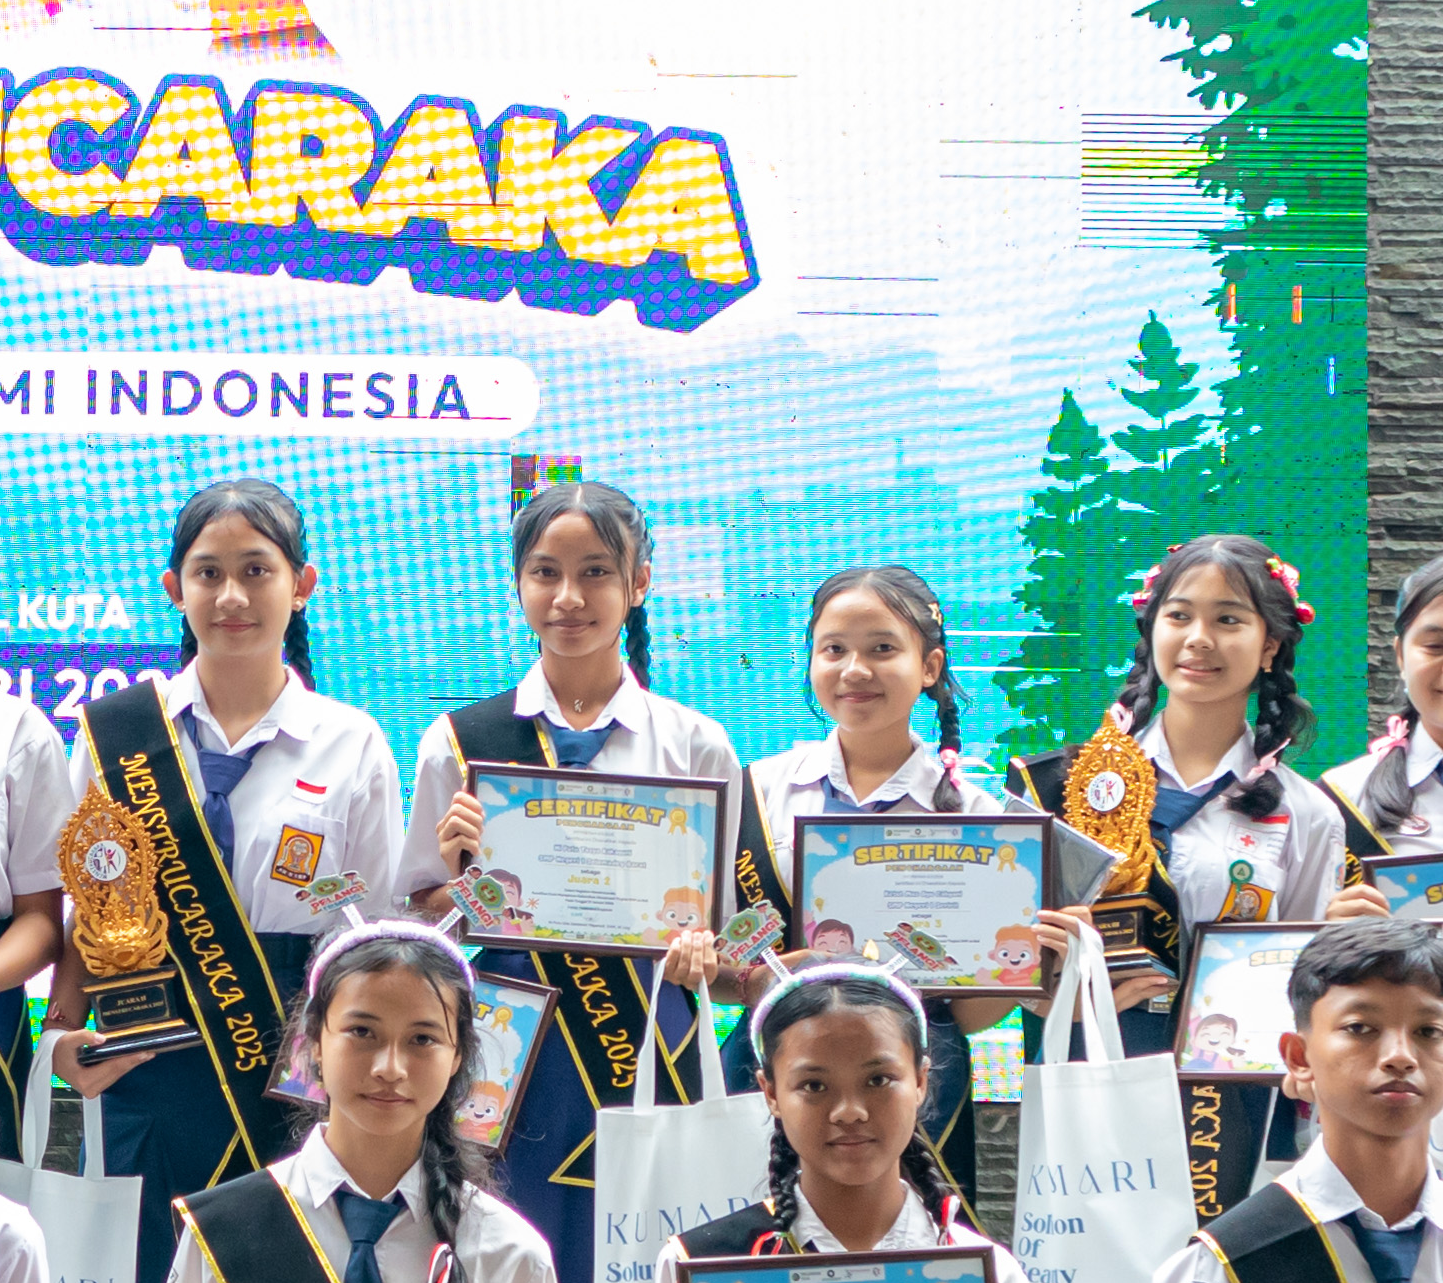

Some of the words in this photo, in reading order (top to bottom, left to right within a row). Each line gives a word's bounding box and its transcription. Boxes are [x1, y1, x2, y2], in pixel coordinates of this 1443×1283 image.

[87, 369, 471, 421] INDONESIA
[18, 593, 131, 630] KUTA
[524, 799, 666, 826] SERTIFIKAT
[854, 843, 995, 867] SERTIFIKAT
[120, 753, 244, 1010] MENSTRUCARAKA
[225, 1013, 268, 1073] 2025
[454, 880, 495, 929] PELANGI
[730, 919, 780, 961] PELANGI
[891, 930, 939, 971] PELANGI
[598, 1028, 638, 1088] 2025
[1019, 1235, 1045, 1259] Of
